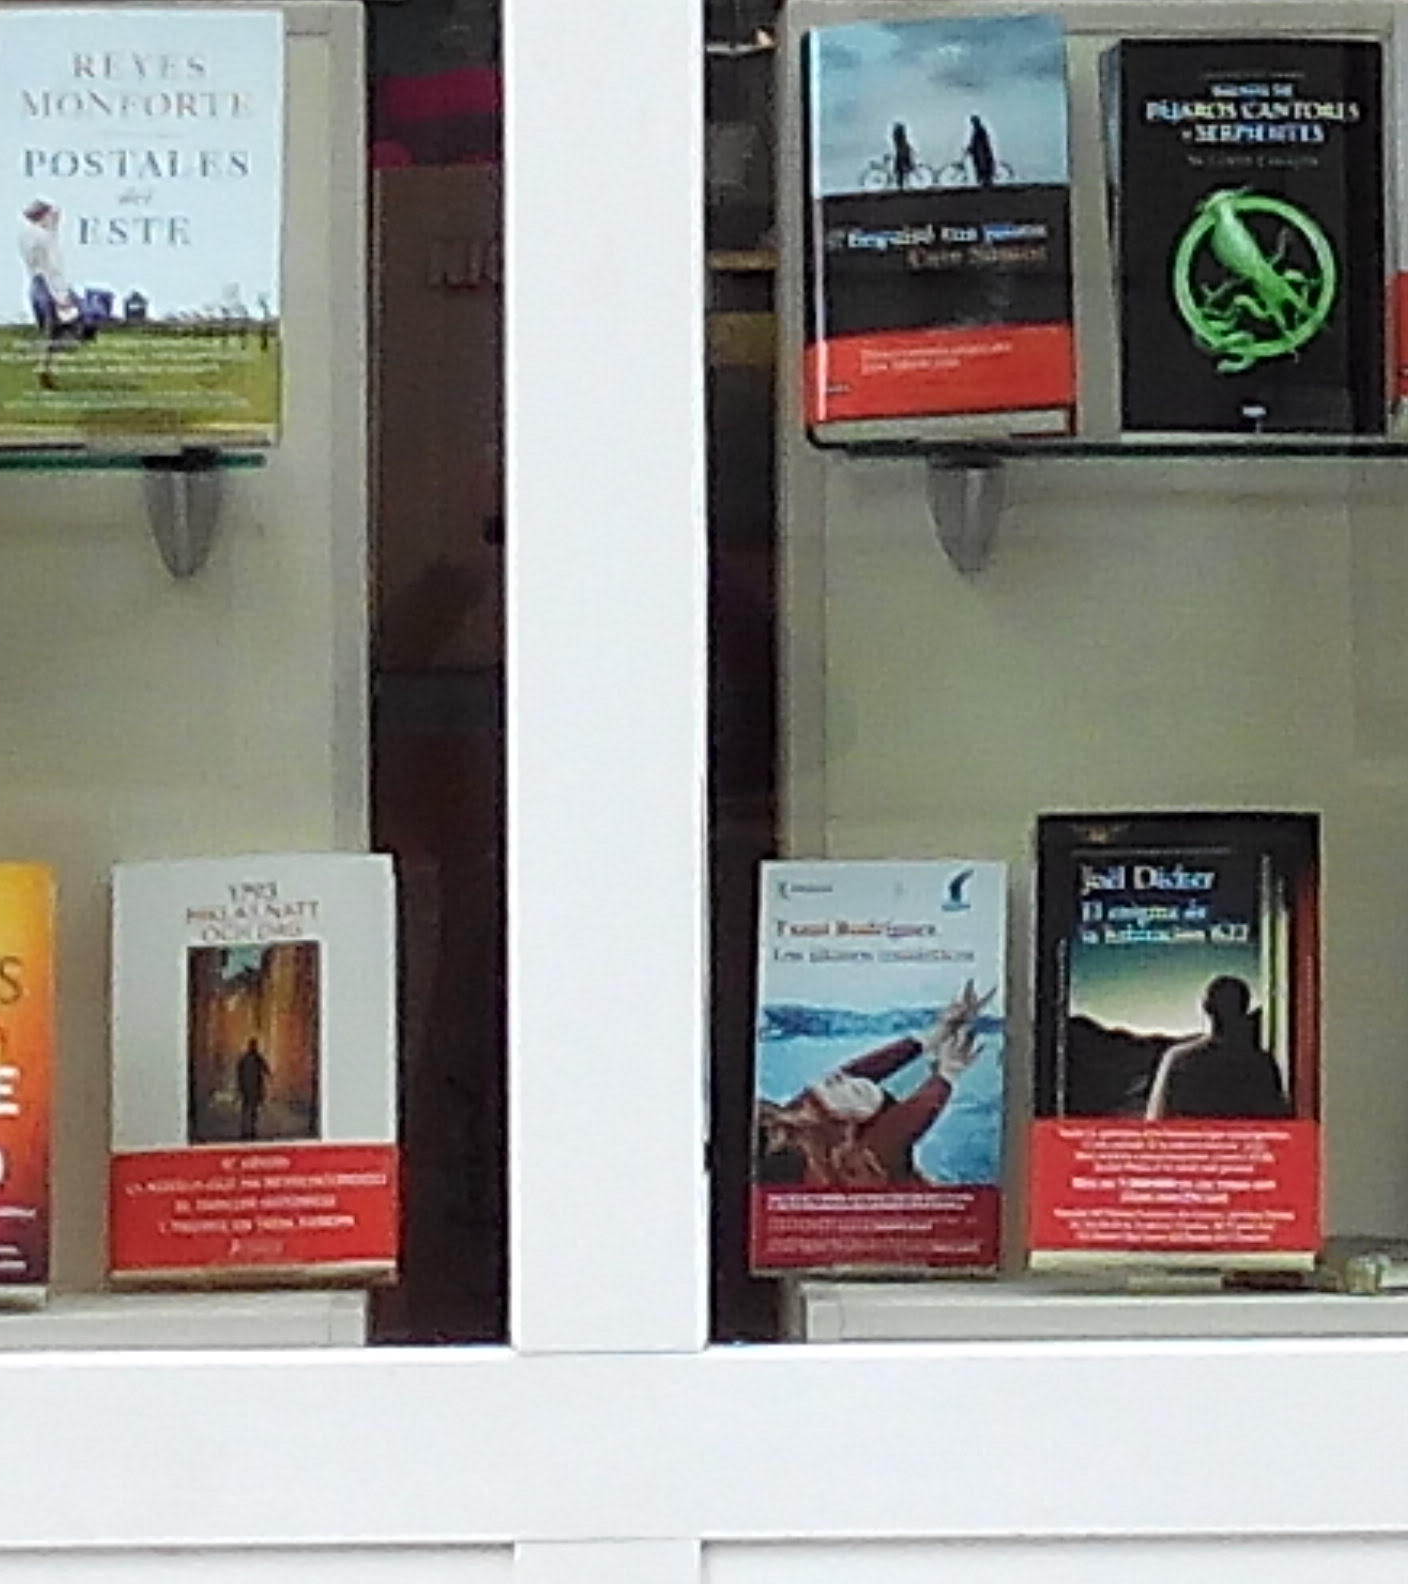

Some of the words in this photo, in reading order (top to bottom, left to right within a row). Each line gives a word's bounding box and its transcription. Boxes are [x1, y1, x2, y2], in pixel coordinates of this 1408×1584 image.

[72, 48, 207, 82] REYES
[22, 88, 254, 119] MONFORTE
[24, 147, 251, 179] POSTALES
[77, 215, 192, 247] ESTE
